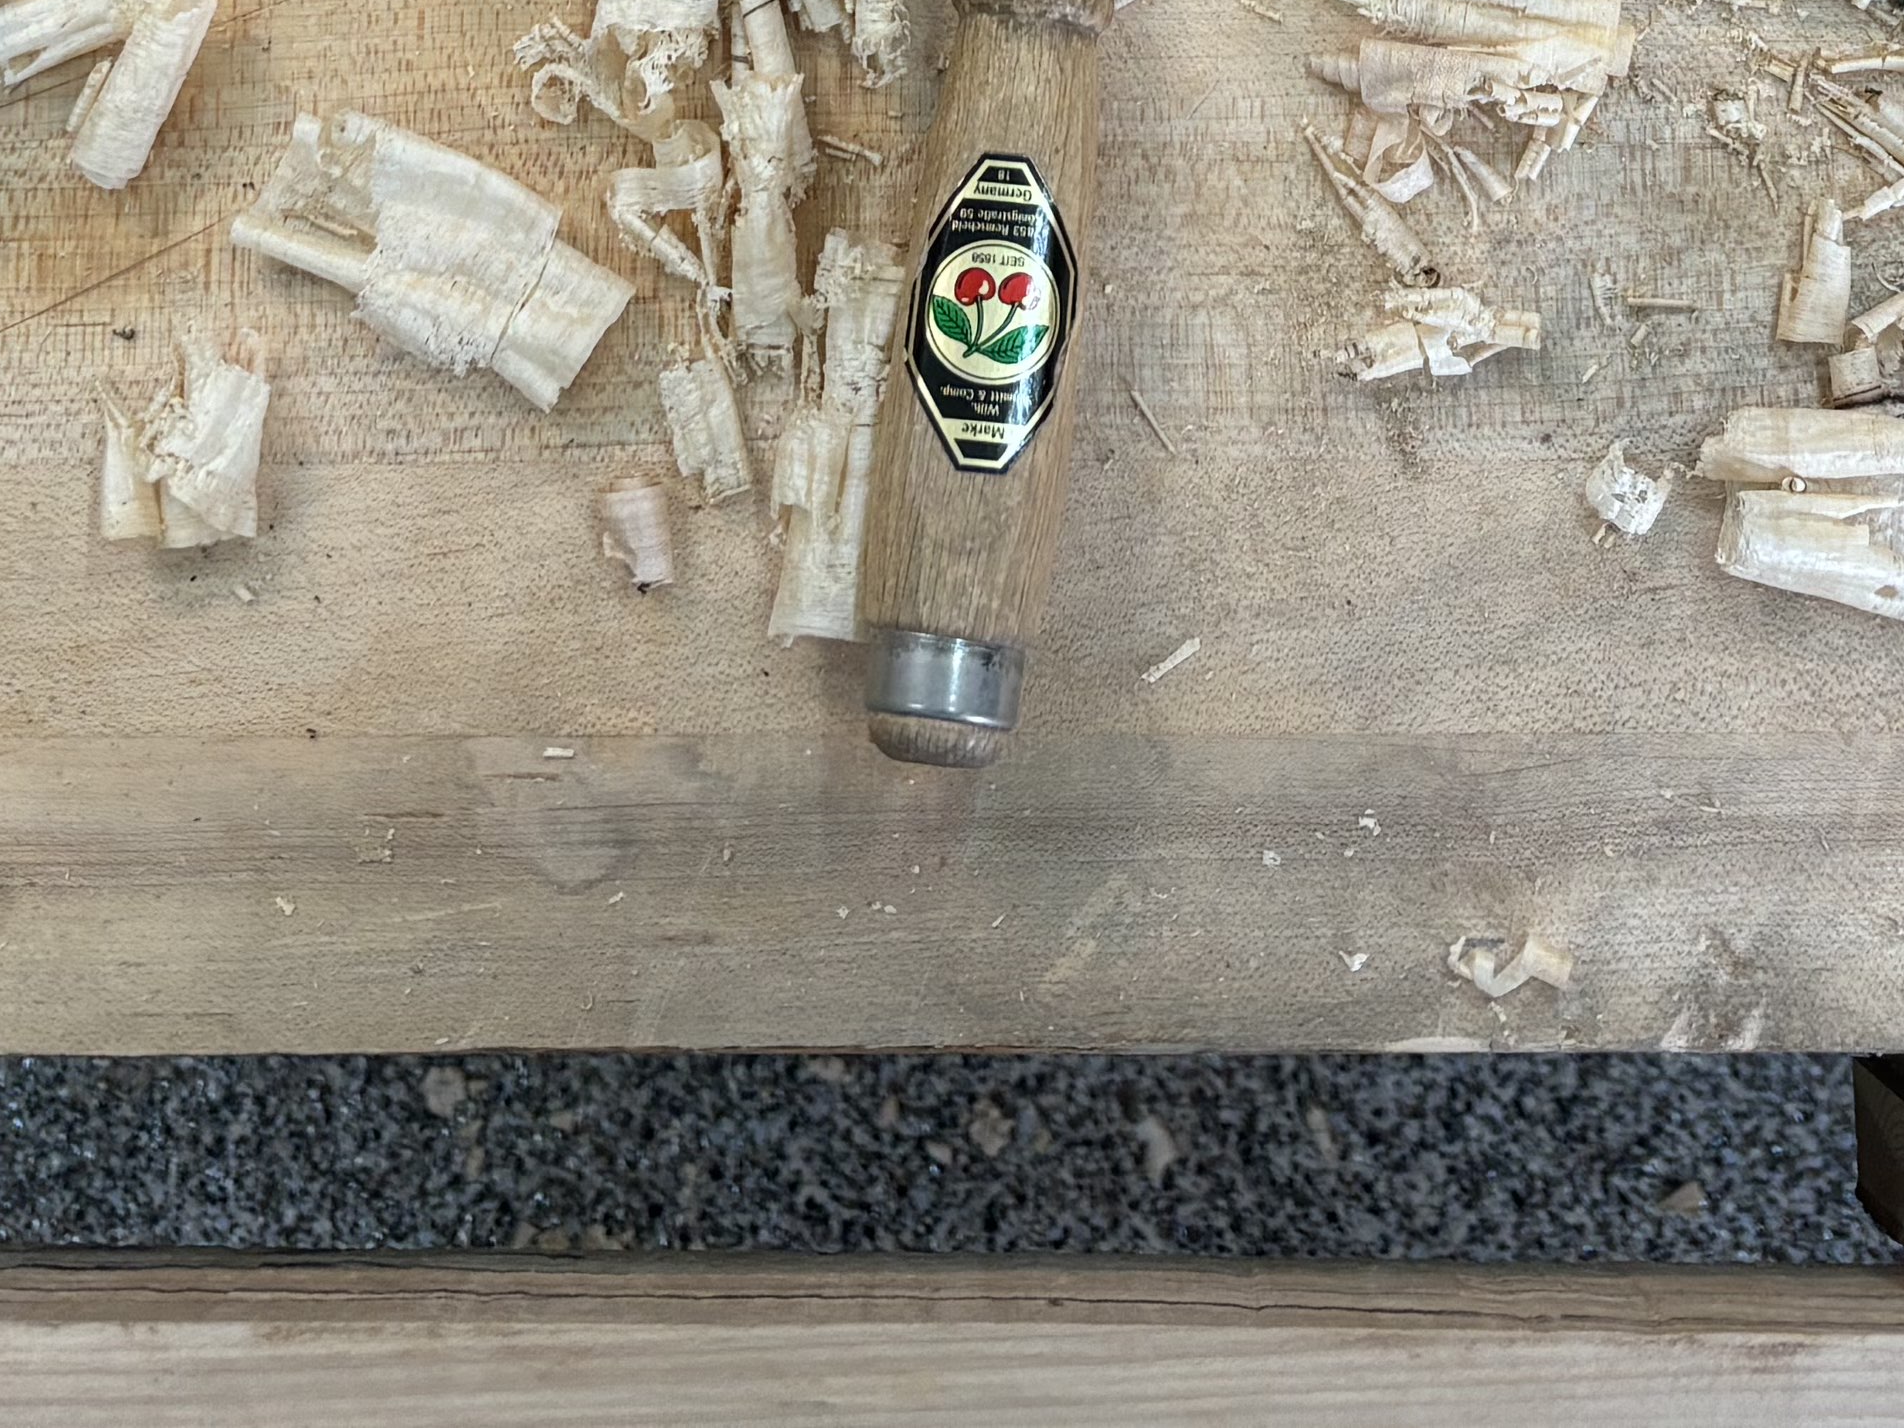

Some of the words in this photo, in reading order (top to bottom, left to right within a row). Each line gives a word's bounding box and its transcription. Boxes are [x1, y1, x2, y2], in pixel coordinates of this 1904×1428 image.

[973, 182, 1032, 202] Germany
[978, 209, 1037, 224] önigstraße
[999, 256, 1026, 267] SEIT
[939, 384, 975, 401] Comp.
[978, 390, 987, 401] &
[971, 402, 1000, 417] Wilh.
[961, 423, 1005, 440] Marke
